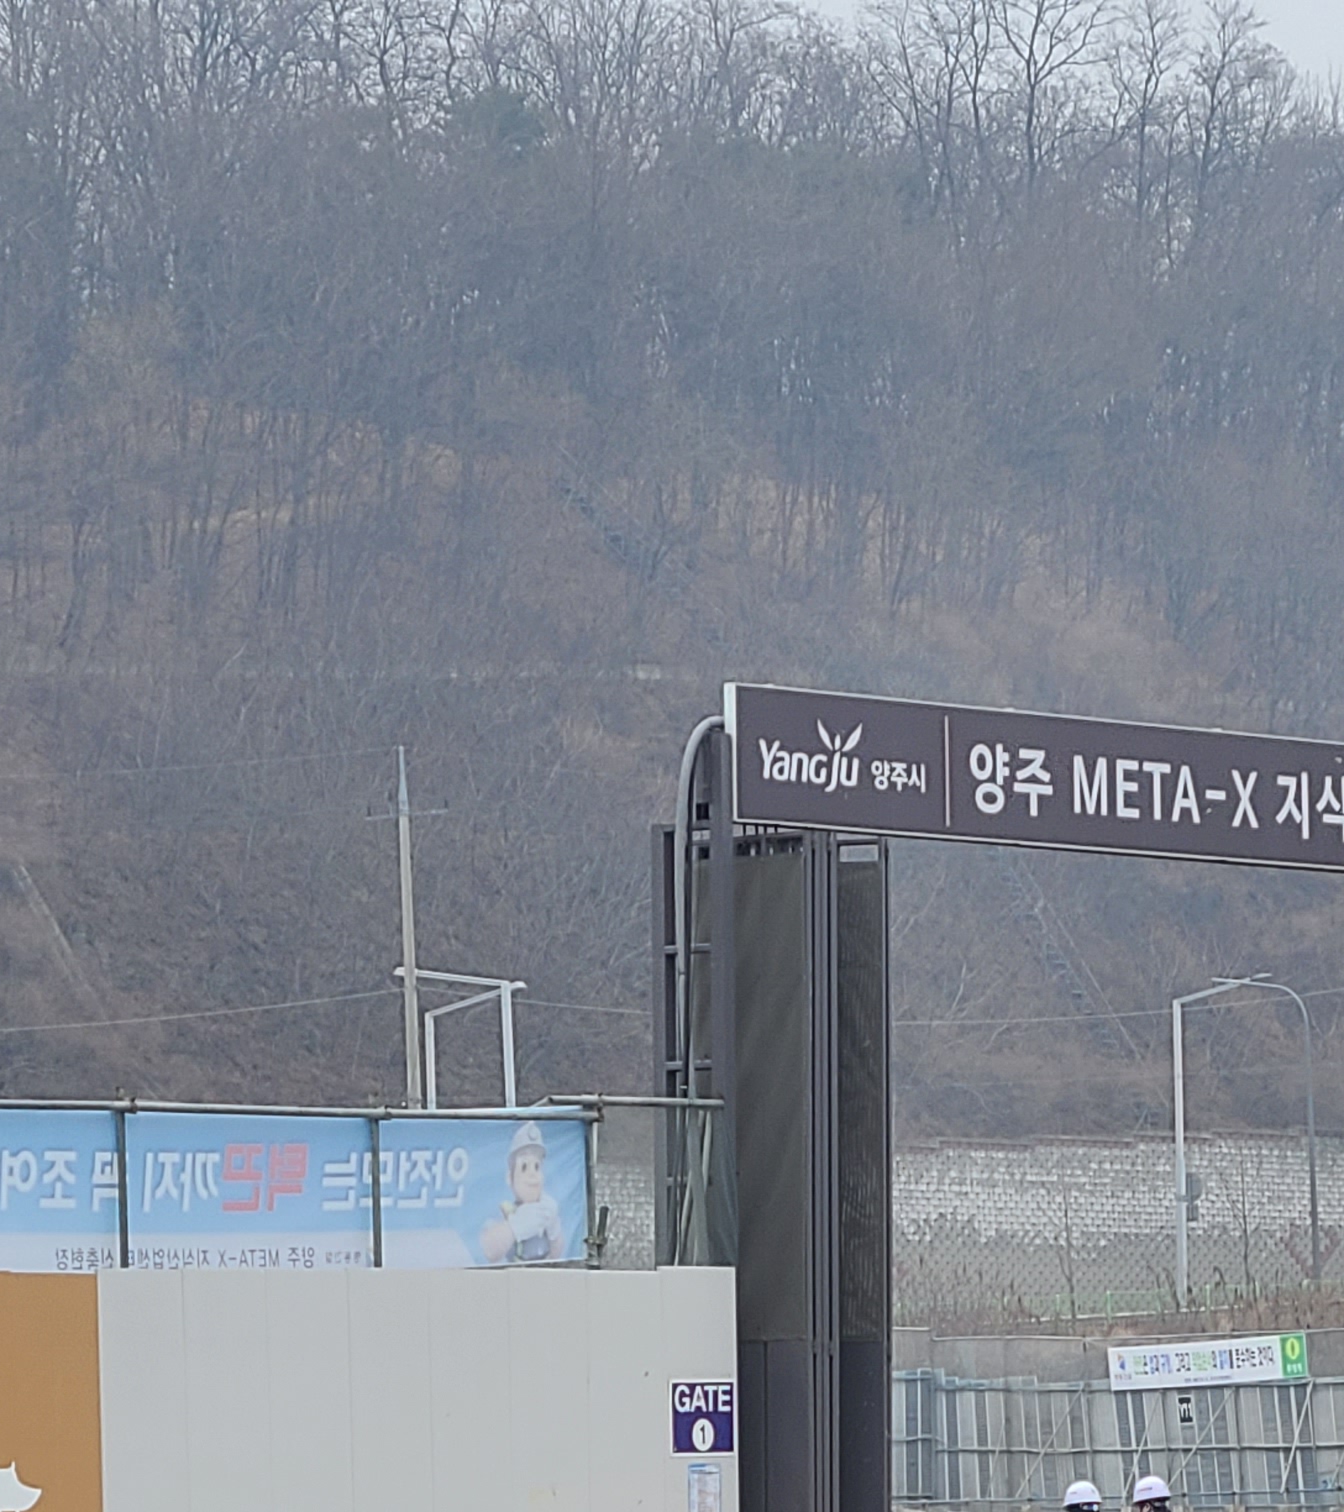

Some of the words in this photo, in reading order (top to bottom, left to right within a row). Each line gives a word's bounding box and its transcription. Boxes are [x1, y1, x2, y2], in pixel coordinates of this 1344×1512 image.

[871, 760, 926, 793] 양주시
[969, 743, 1053, 817] 양주
[1073, 754, 1259, 828] META-X
[674, 1385, 731, 1413] GATE
[699, 1424, 706, 1445] 1
